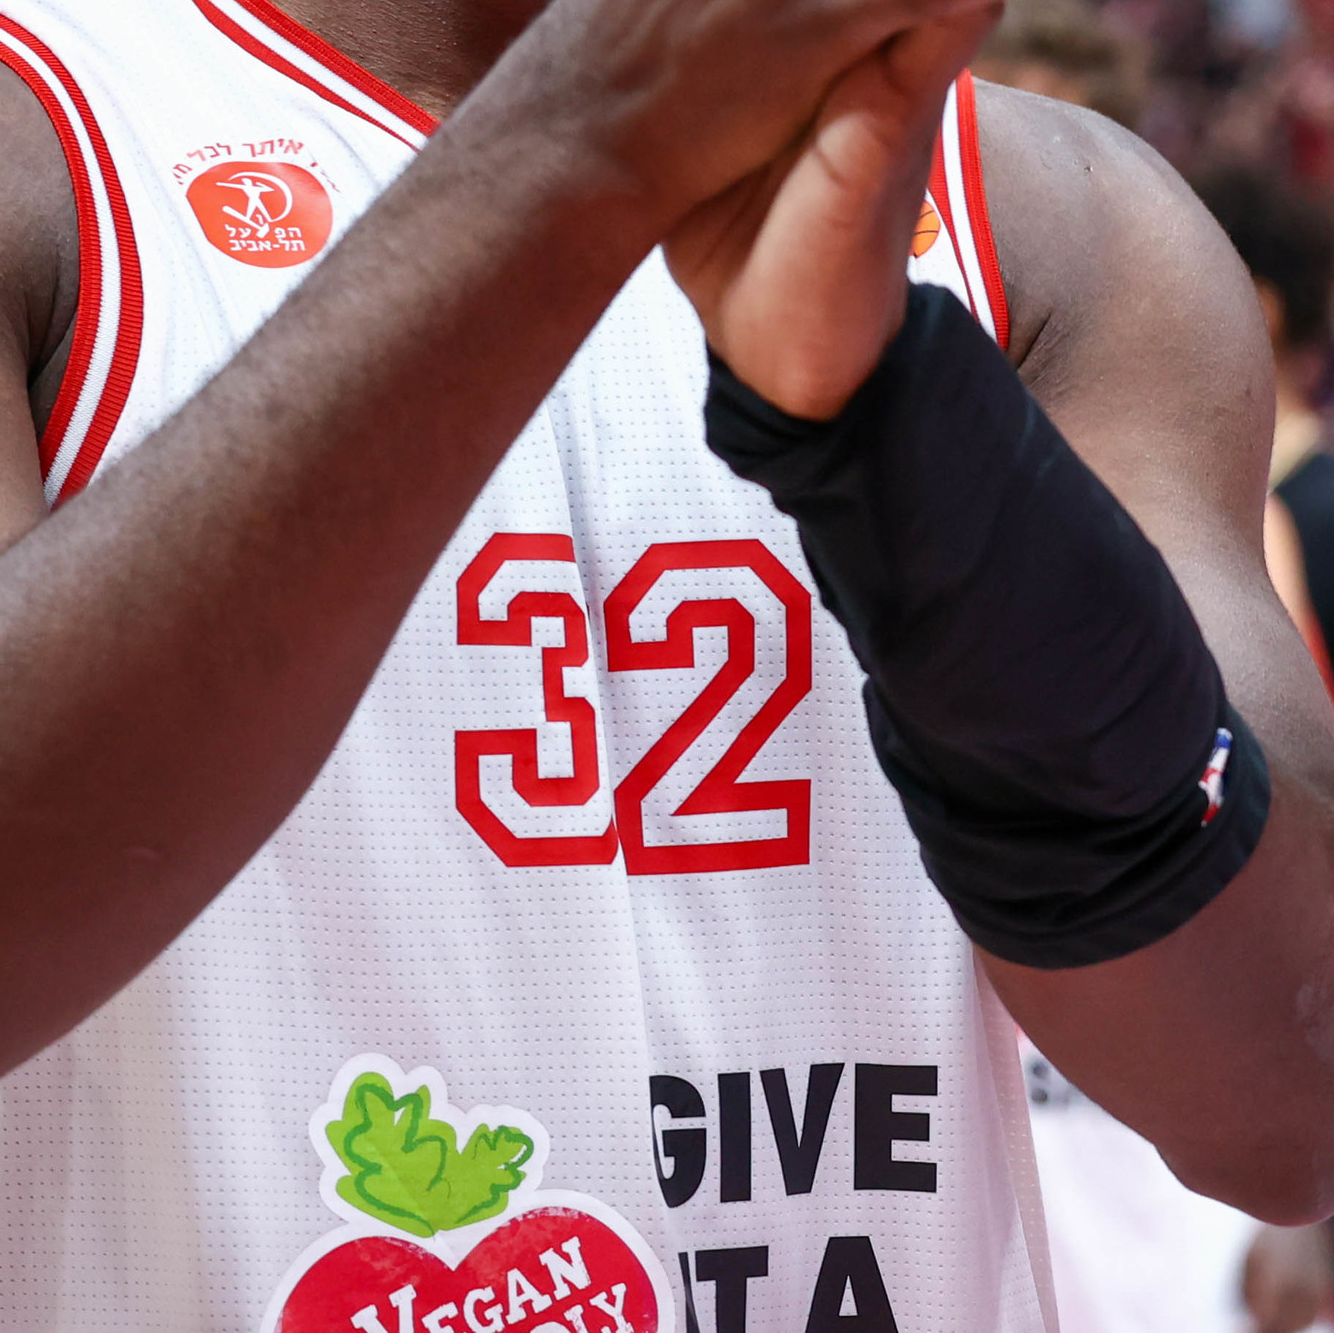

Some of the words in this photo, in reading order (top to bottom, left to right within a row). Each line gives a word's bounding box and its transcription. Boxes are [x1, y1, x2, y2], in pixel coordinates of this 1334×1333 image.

[228, 239, 306, 252] תל-אביב
[454, 532, 812, 876] 32
[648, 1062, 938, 1208] GIVE
[350, 1236, 592, 1333] VEGAN
[678, 1245, 769, 1333] T
[805, 1235, 900, 1333] A
